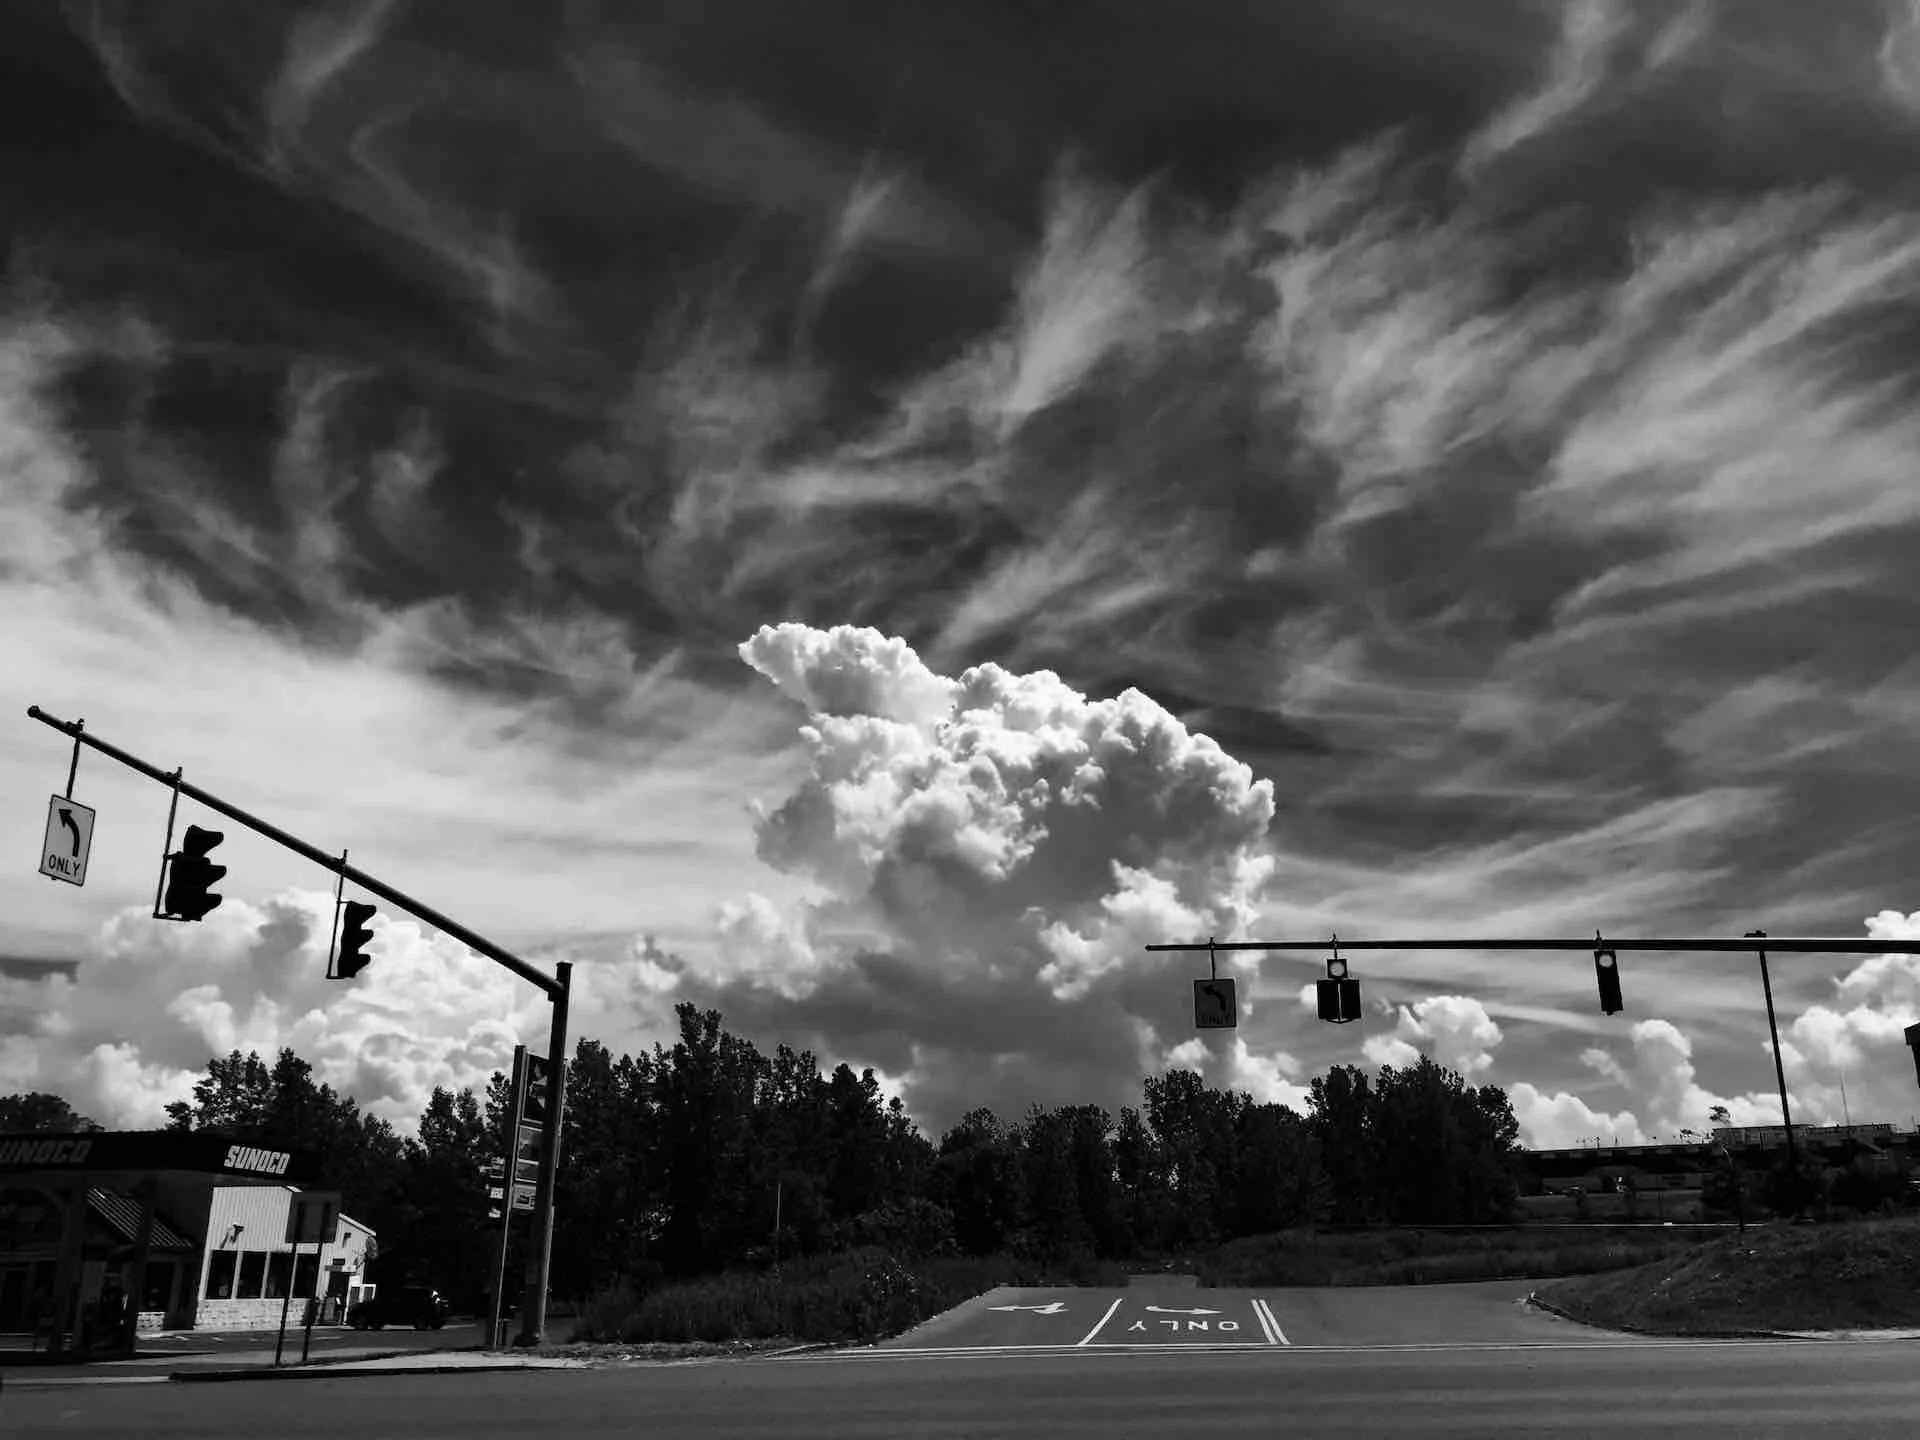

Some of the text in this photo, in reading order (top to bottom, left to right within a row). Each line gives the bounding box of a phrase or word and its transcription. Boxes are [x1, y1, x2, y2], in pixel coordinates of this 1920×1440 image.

[49, 854, 80, 876] ONLY
[0, 1140, 94, 1163] UNOCO
[223, 1144, 291, 1175] SUNOCO
[1127, 1320, 1240, 1332] ONLY
